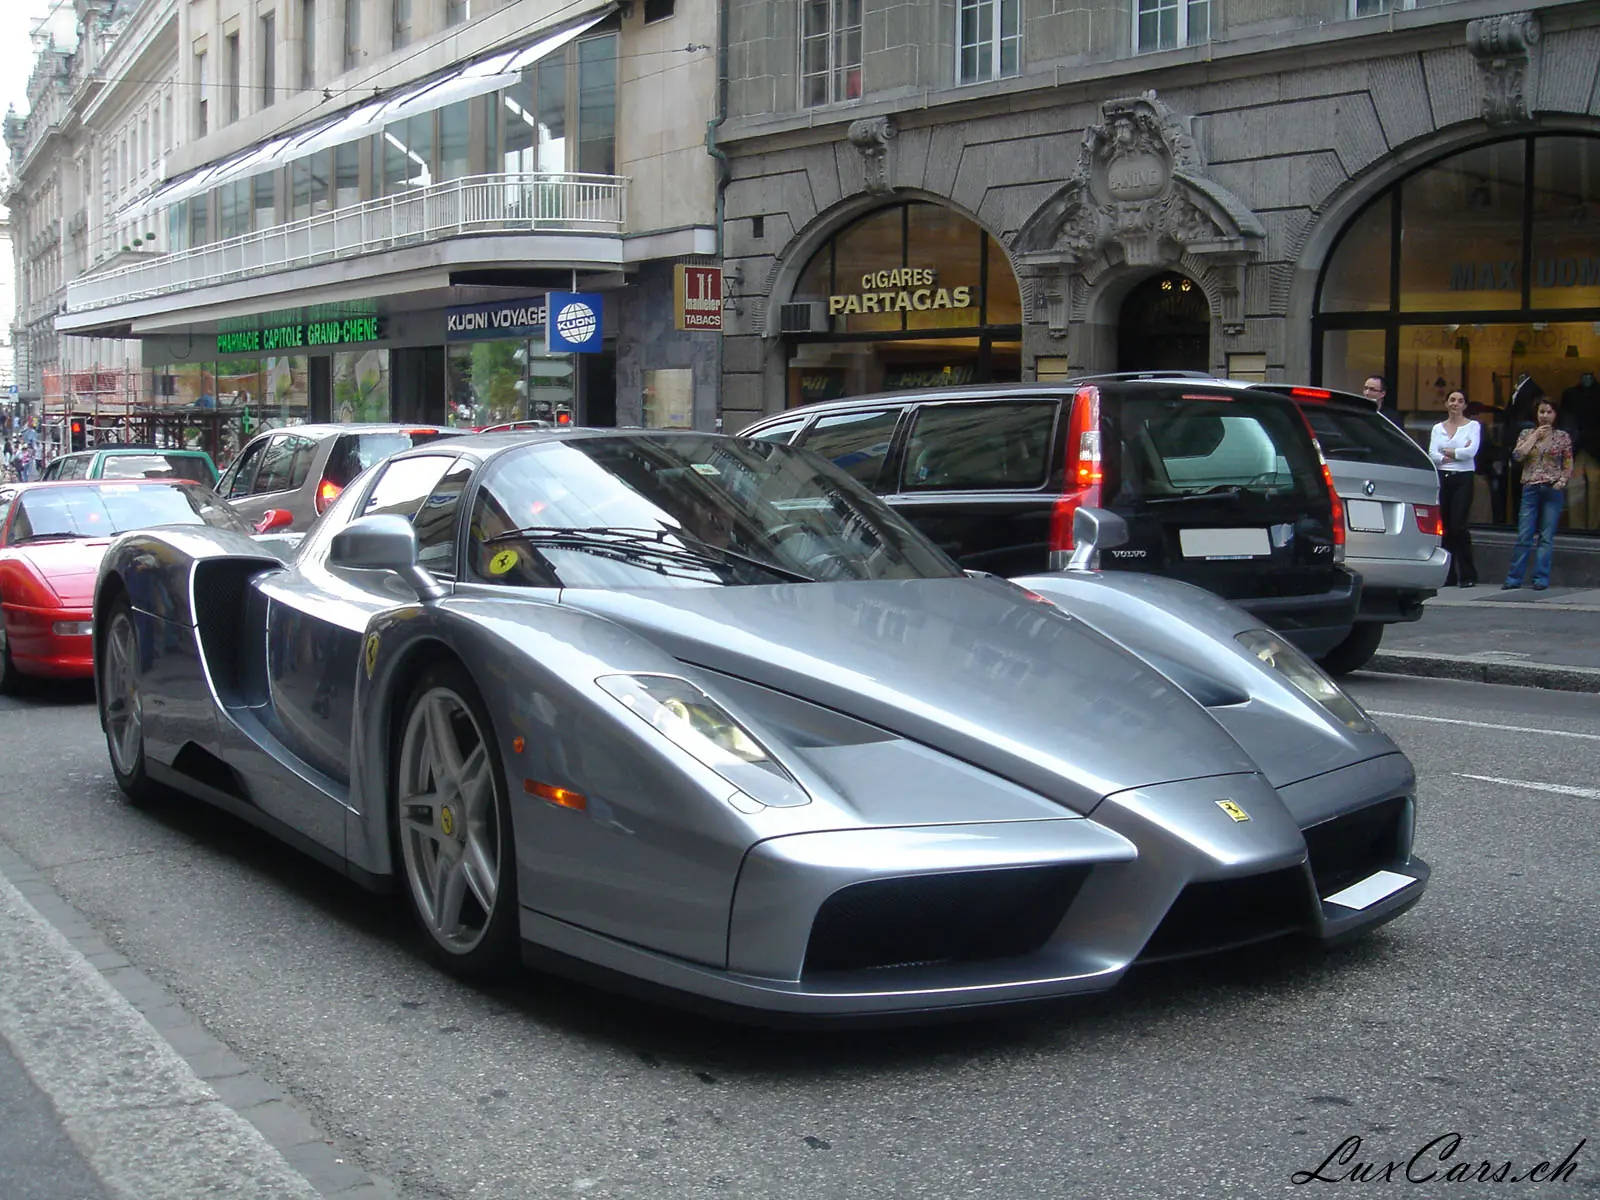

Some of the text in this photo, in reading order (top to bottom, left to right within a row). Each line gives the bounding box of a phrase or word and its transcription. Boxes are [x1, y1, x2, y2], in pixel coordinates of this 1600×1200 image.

[862, 268, 933, 289] CIGARES
[1450, 260, 1516, 290] MAX
[829, 286, 970, 315] PARTAGAS
[448, 312, 488, 331] KUONI
[557, 315, 596, 331] KUONI
[685, 314, 720, 325] TABACS
[217, 330, 260, 353] PHARMACIE
[263, 324, 303, 350] CAPITOLE
[1112, 550, 1147, 558] VOLVO
